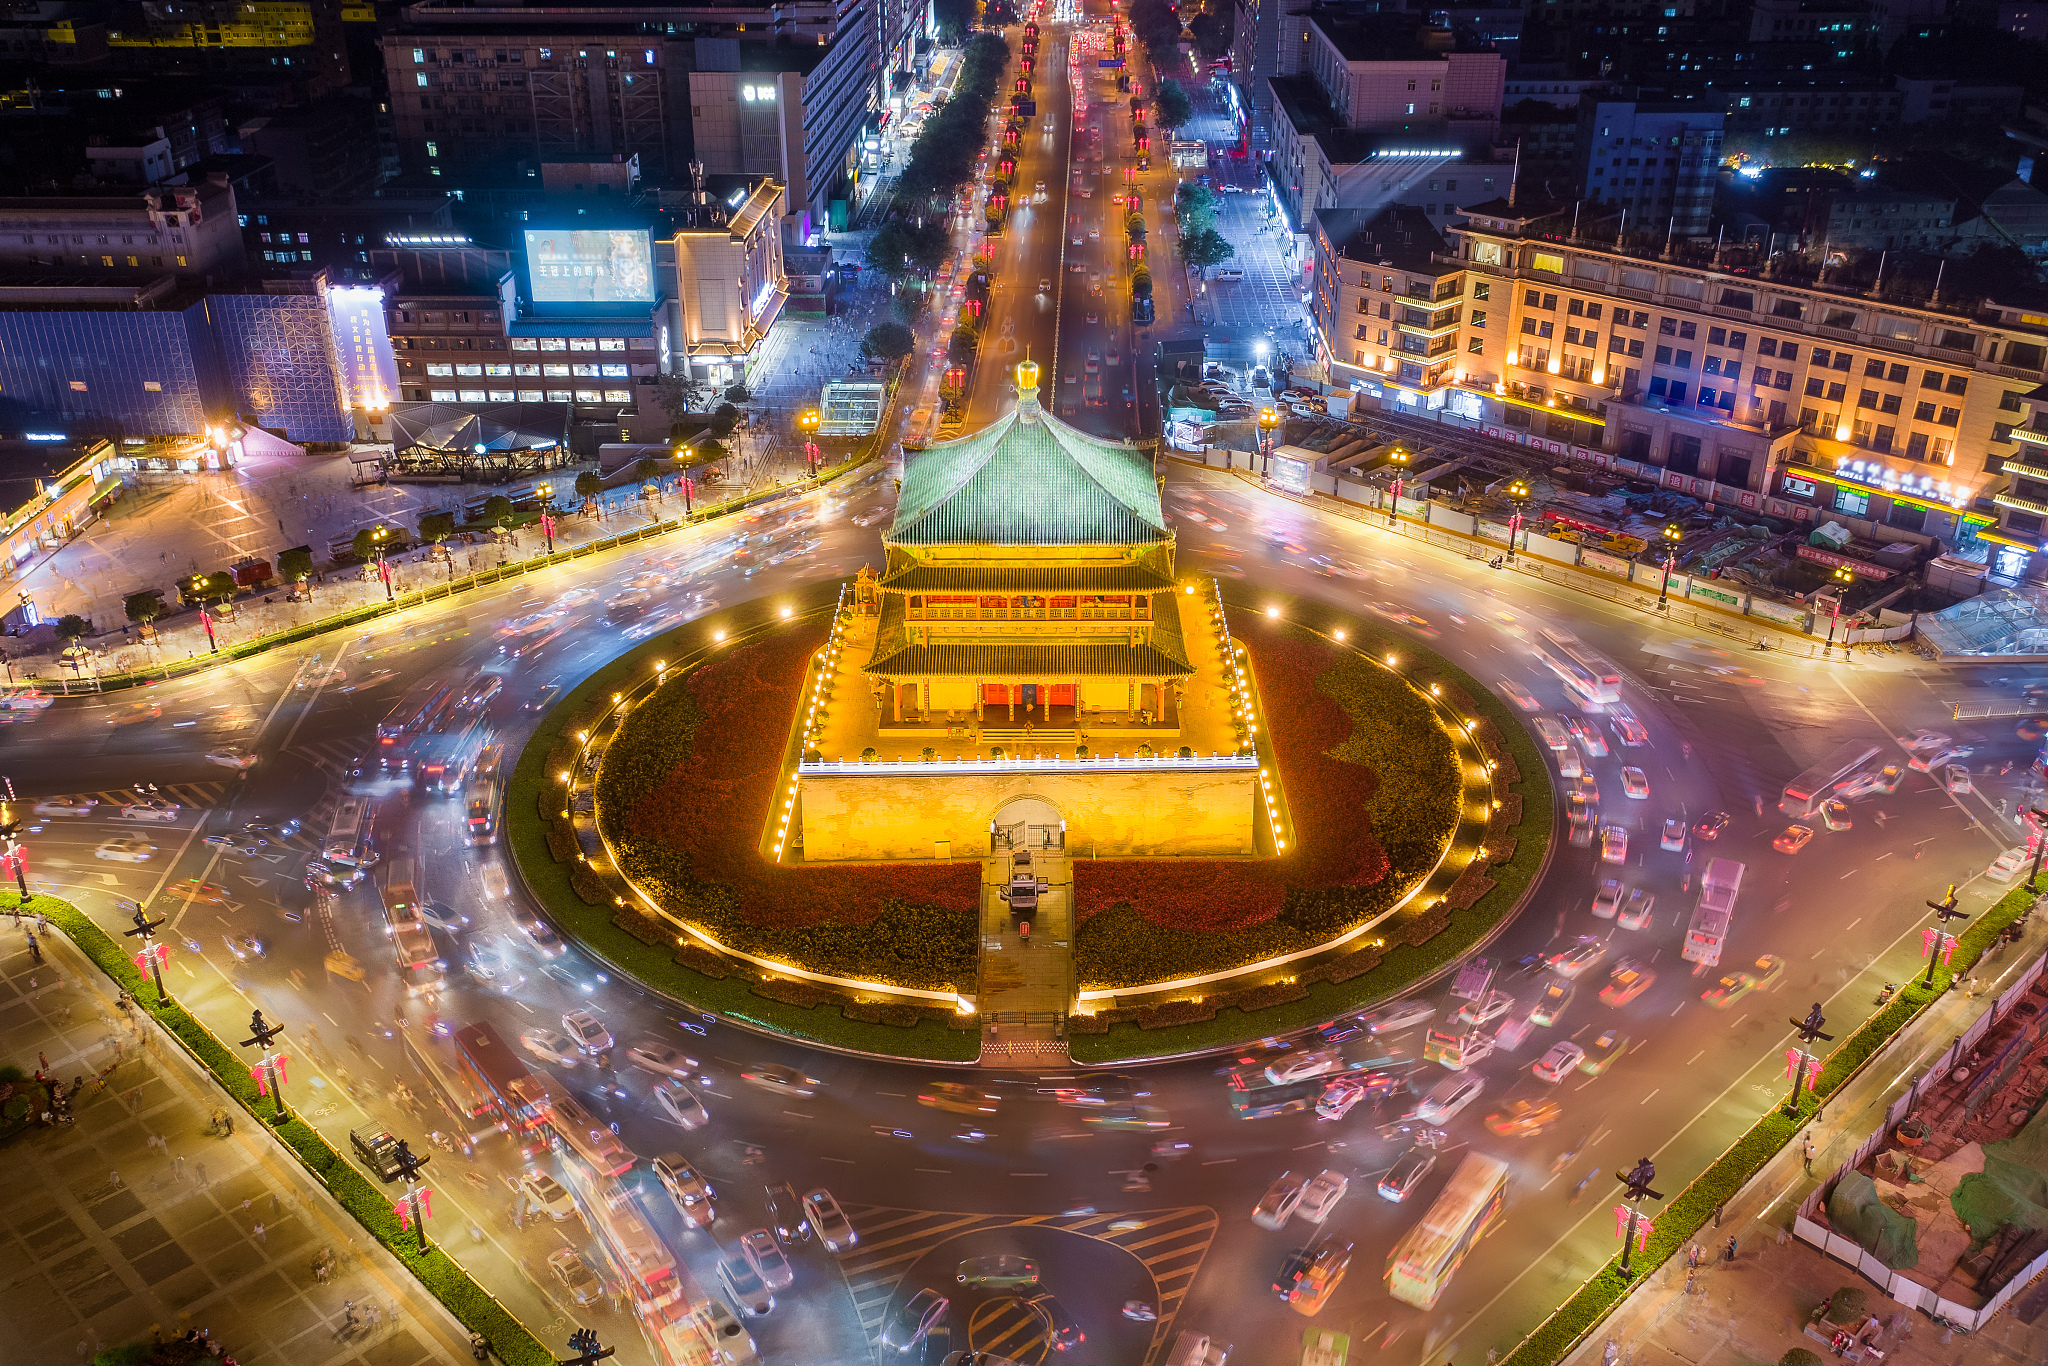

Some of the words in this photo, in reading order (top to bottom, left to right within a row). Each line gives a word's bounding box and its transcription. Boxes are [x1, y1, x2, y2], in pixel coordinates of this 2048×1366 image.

[539, 265, 605, 277] 王冠上的明珠
[1835, 469, 1864, 482] POSTAL
[1866, 476, 1900, 491] SAVIS
[1901, 485, 1924, 496] BANK
[1925, 491, 1938, 499] OF
